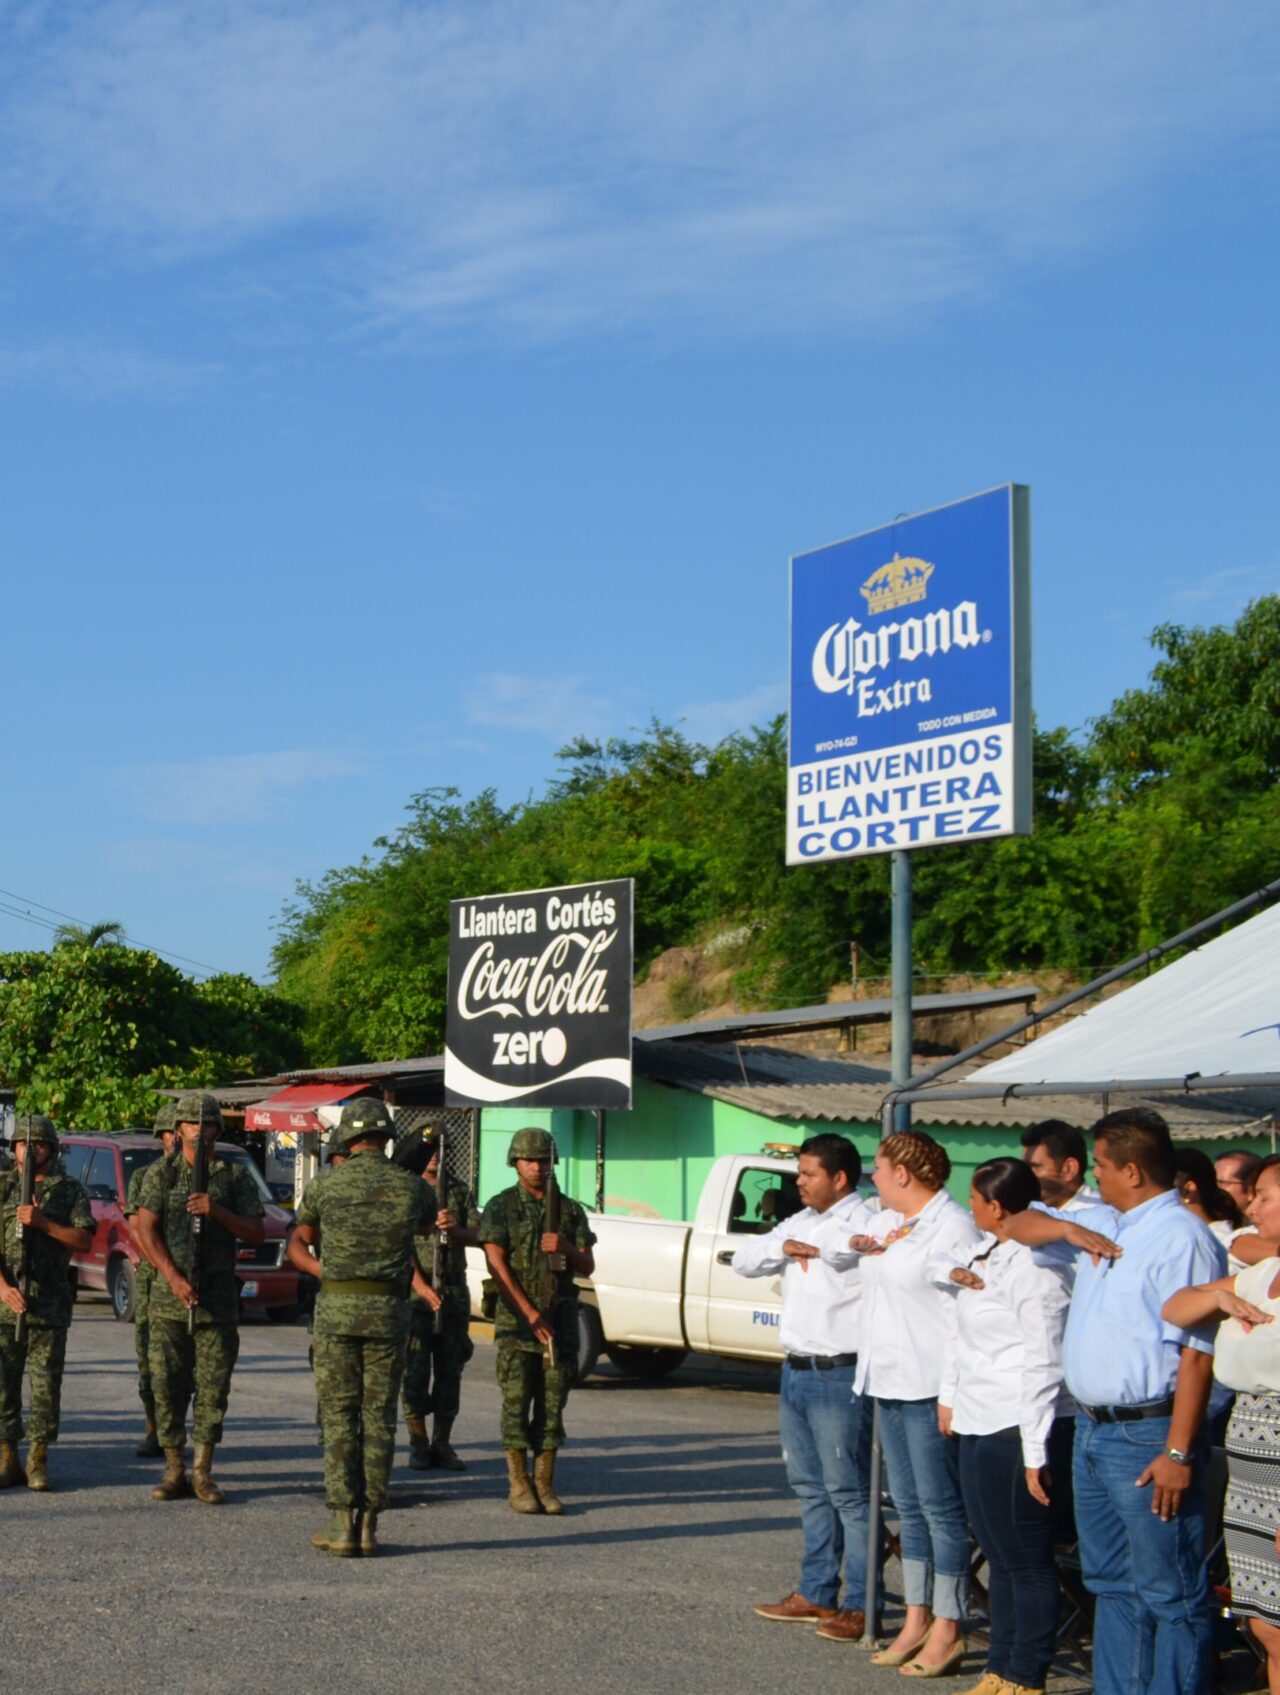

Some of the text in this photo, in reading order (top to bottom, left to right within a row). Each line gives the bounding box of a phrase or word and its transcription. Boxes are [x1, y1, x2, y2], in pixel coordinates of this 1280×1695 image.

[812, 600, 981, 696] Corona
[857, 677, 932, 718] Extra
[918, 707, 998, 733] TODO CON MEDIDA
[797, 734, 1003, 796] BIENVENIDOS
[797, 771, 1002, 828] LLANTERA
[798, 804, 1001, 857] CORTEZ
[460, 891, 616, 938] Llantera Cortés
[457, 928, 618, 1020] Coca-Cola
[492, 1027, 567, 1066] zero
